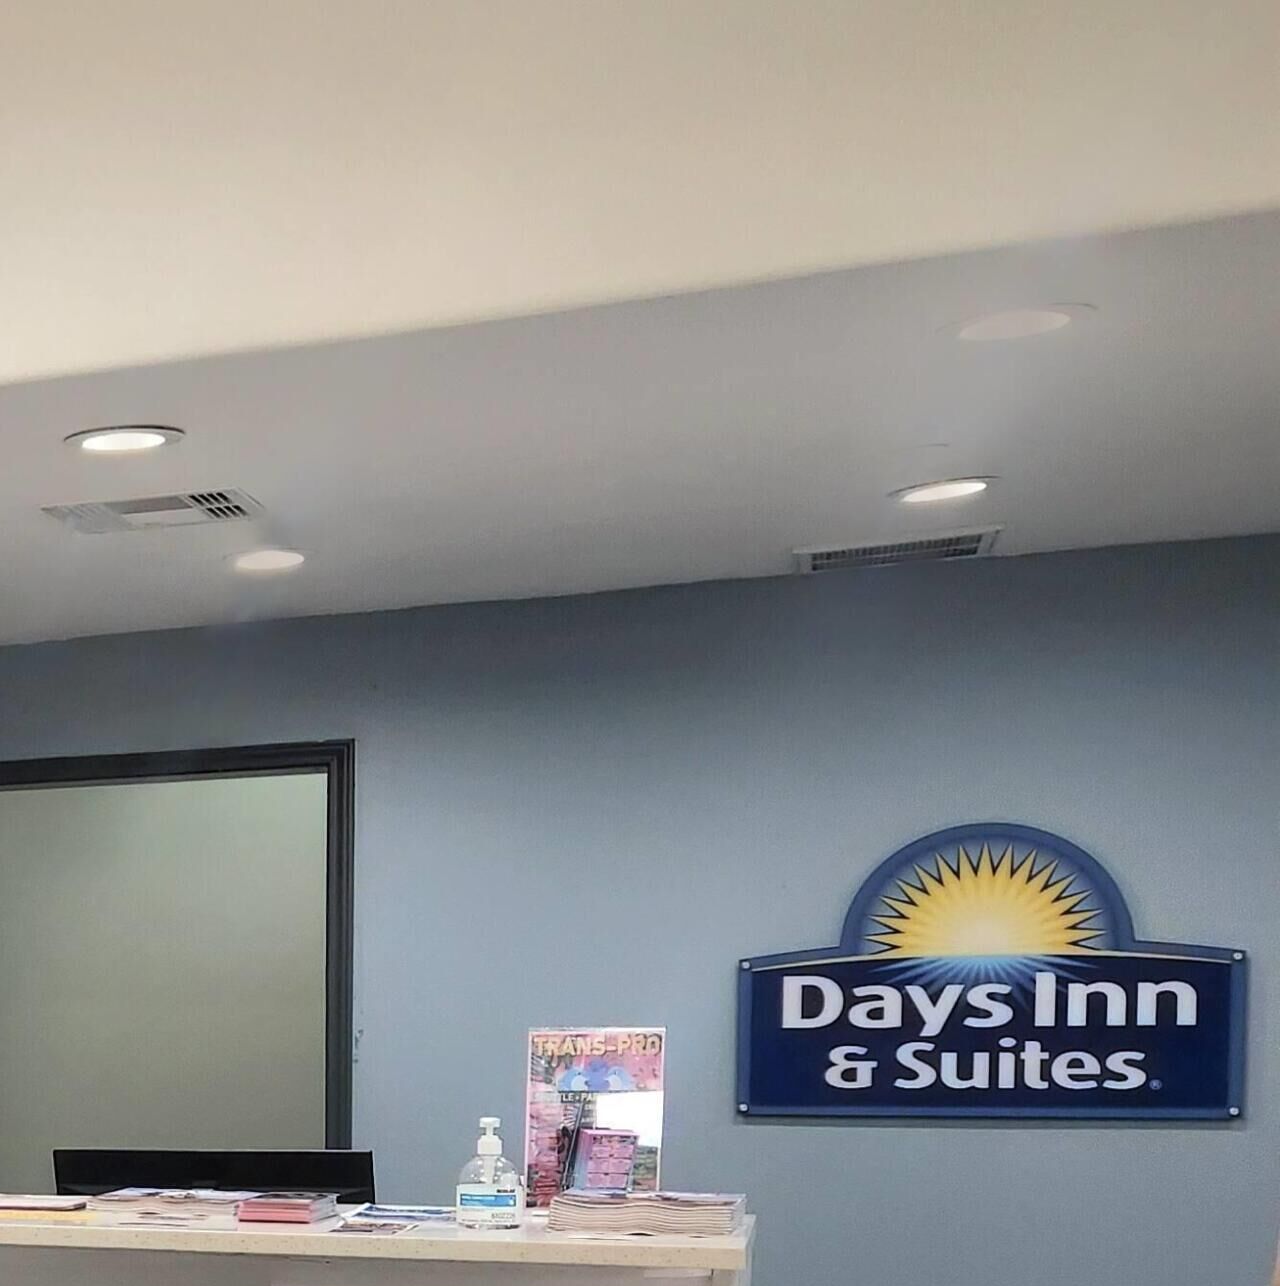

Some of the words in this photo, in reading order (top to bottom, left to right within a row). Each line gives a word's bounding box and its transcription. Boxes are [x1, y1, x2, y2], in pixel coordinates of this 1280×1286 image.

[781, 974, 1014, 1037] Days
[1034, 971, 1198, 1027] Inn
[533, 1034, 662, 1057] TRANS-PRO
[824, 1044, 878, 1089] &
[893, 1036, 1147, 1090] Suites
